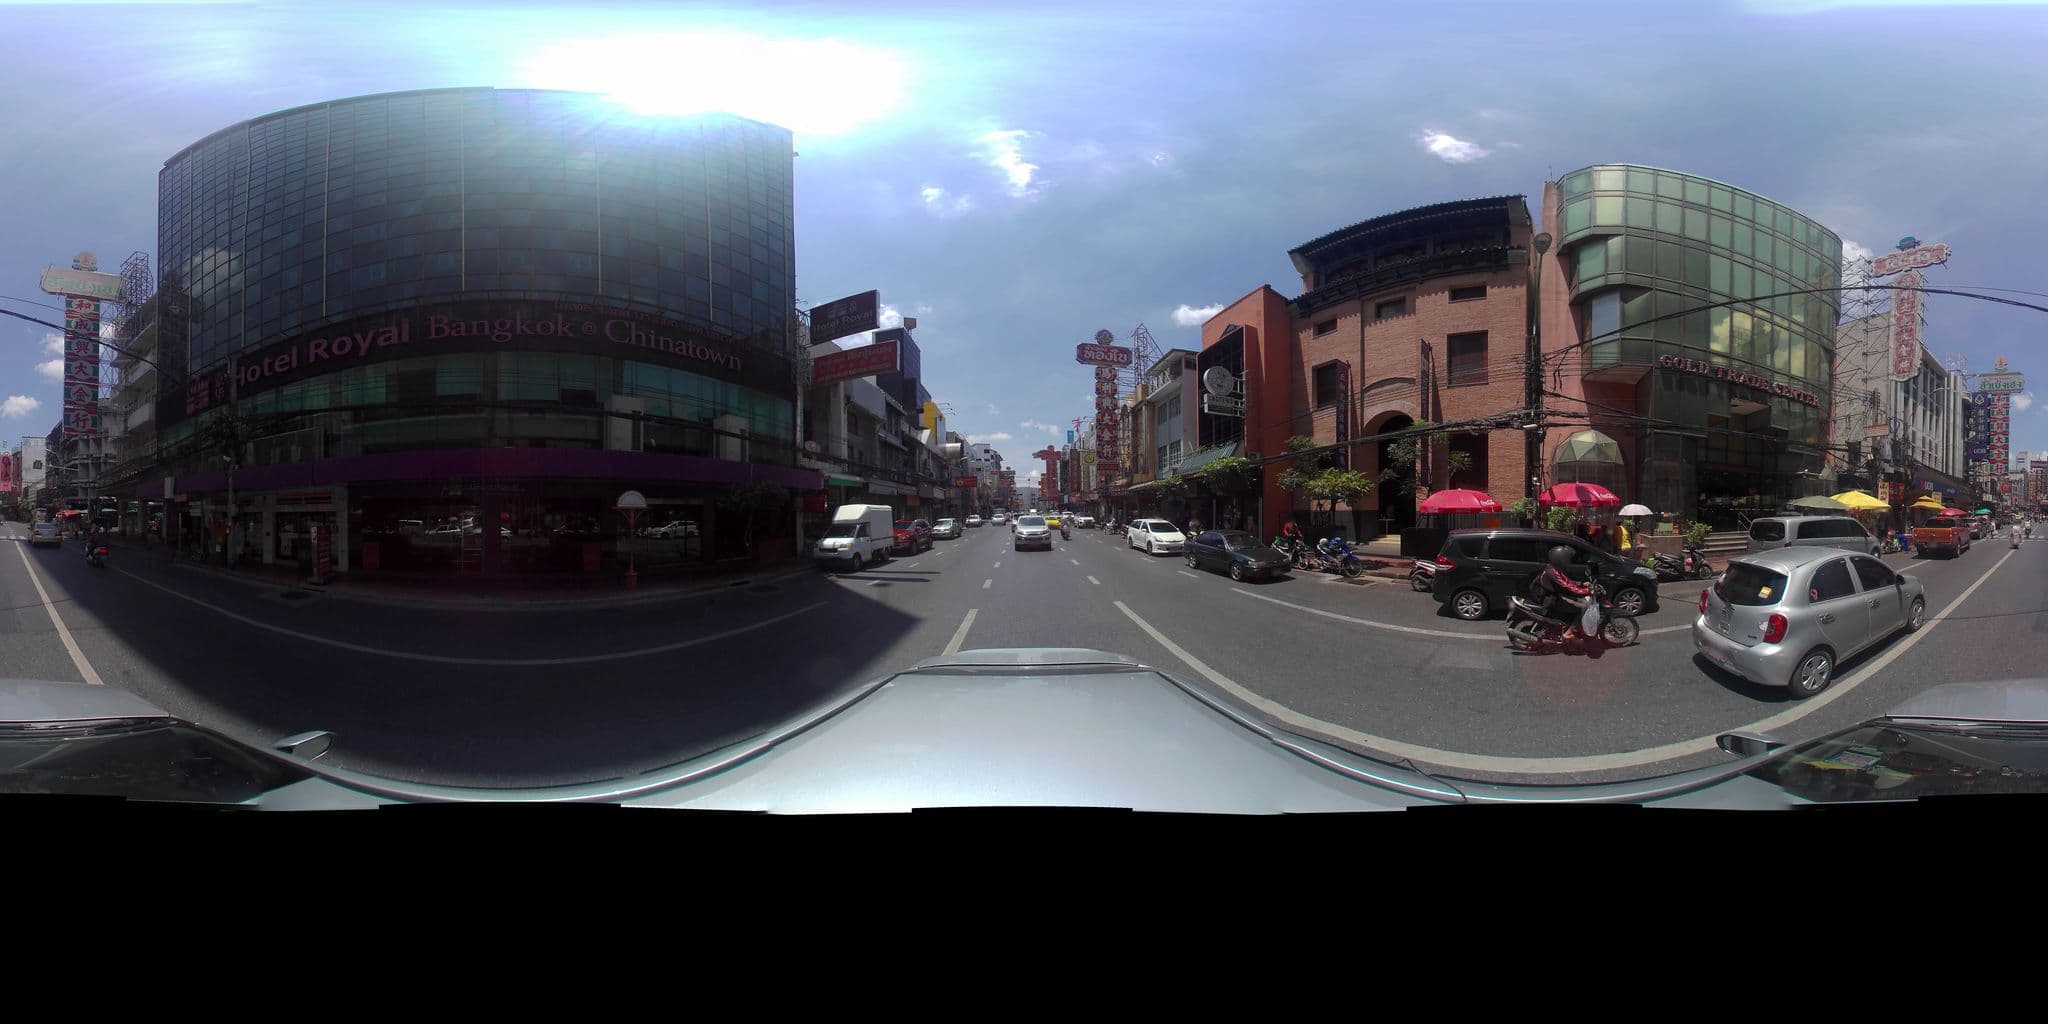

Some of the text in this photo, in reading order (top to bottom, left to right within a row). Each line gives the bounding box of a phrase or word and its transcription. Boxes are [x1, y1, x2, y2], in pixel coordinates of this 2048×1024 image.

[842, 310, 874, 326] Royal
[233, 346, 298, 386] Hotel
[308, 319, 410, 363] Royal
[427, 311, 574, 343] Bangkok
[603, 318, 743, 371] Chinatown
[1660, 354, 1821, 408] GOLD TRADE CENTER
